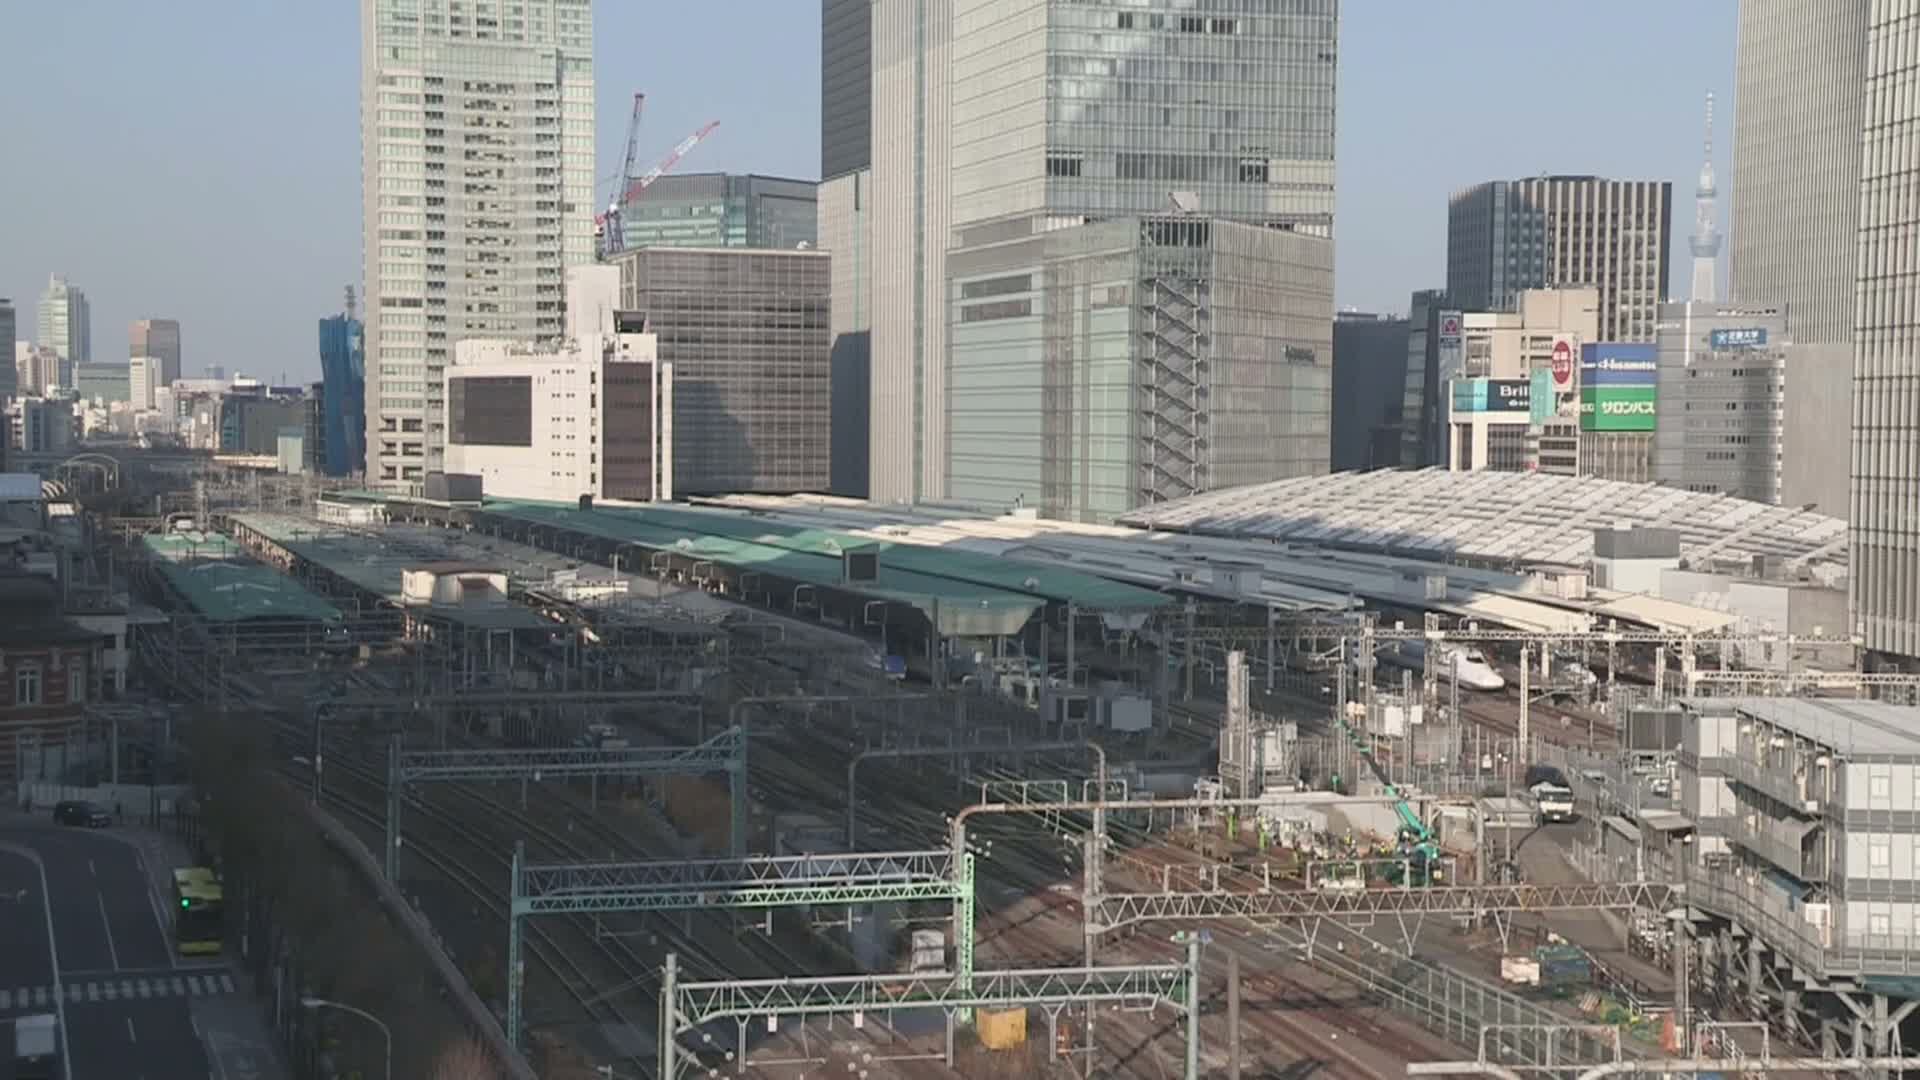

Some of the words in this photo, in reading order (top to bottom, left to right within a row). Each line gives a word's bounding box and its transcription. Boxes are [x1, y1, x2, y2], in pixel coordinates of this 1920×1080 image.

[1601, 400, 1656, 414] サロンパス
